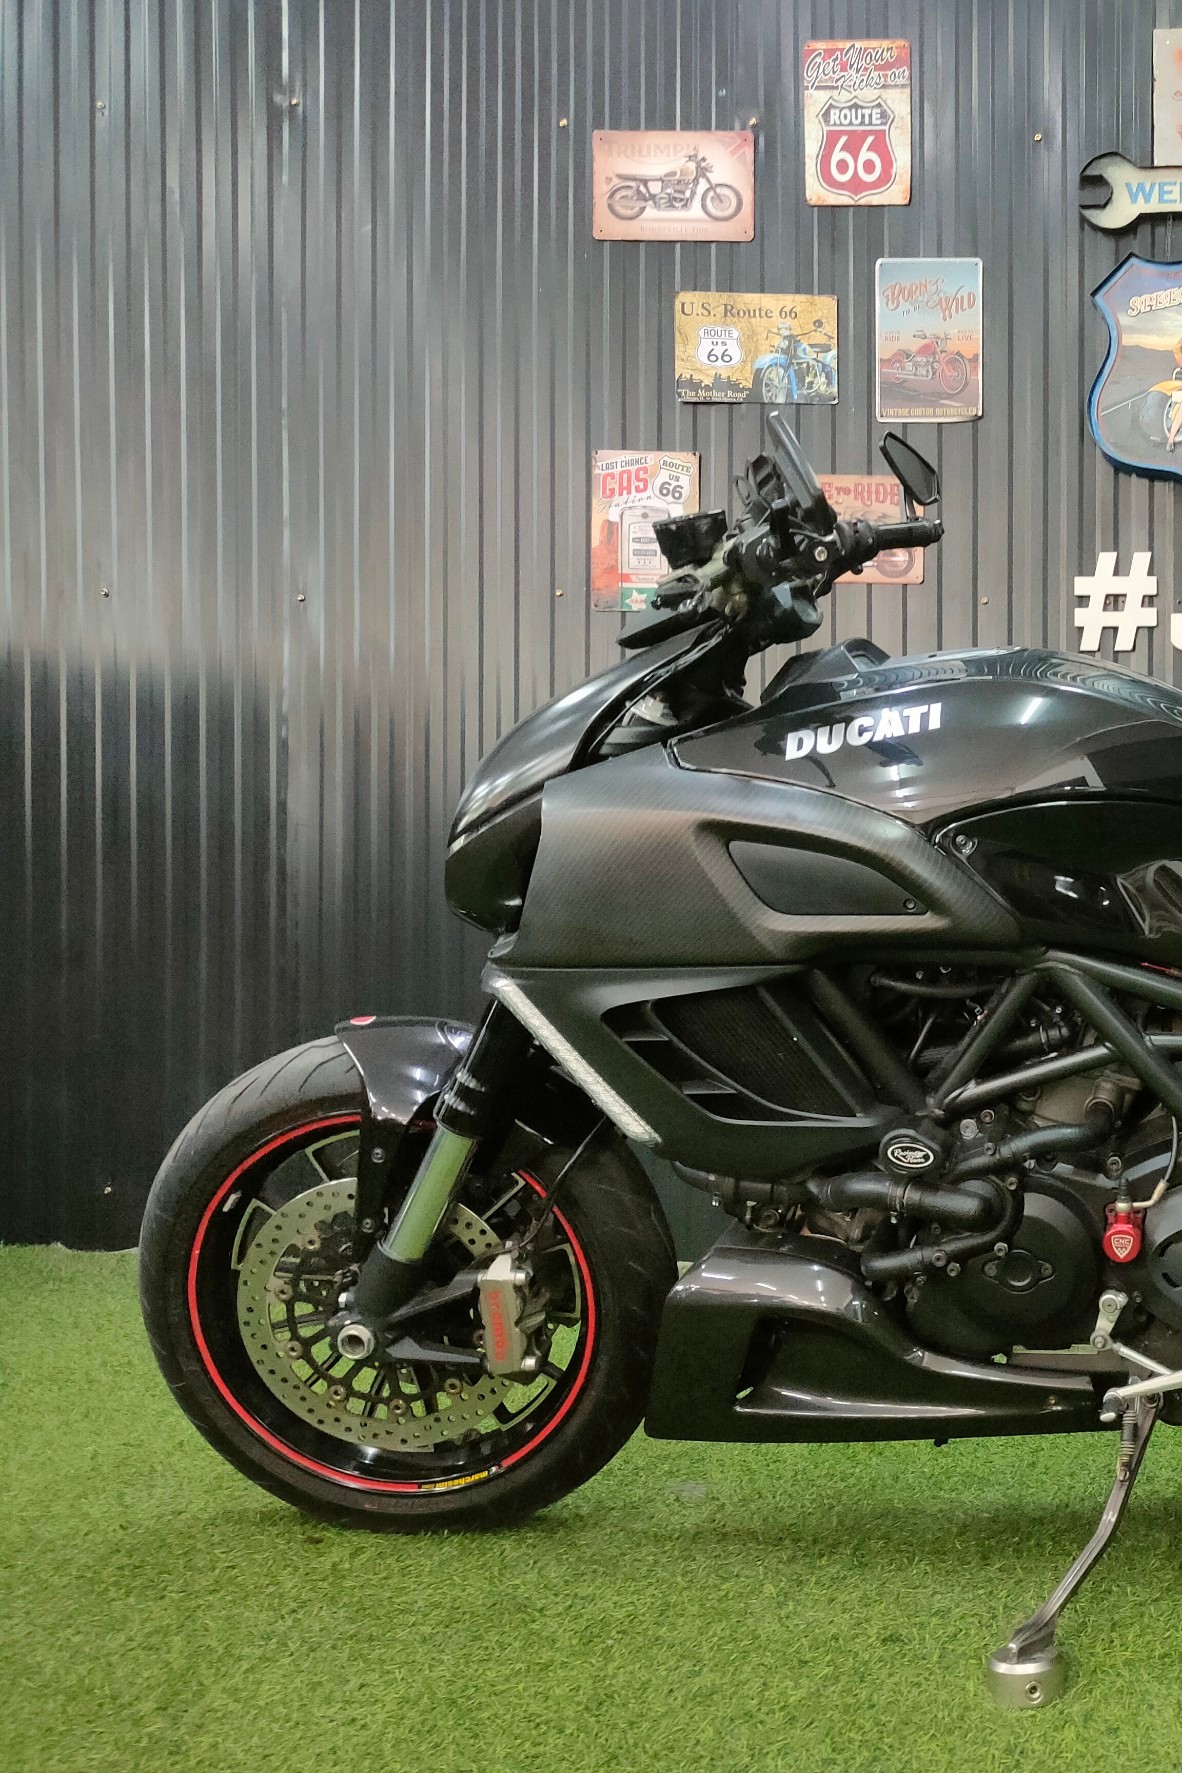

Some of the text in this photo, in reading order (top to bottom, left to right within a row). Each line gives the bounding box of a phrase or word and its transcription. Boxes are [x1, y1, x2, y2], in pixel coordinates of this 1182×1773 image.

[805, 43, 896, 90] Get Your
[835, 67, 908, 96] Kicks on
[829, 108, 882, 125] ROUTE
[830, 135, 882, 183] 66
[680, 302, 798, 320] U.S. Route 66
[703, 328, 734, 338] ROUTE
[706, 348, 733, 363] 66
[697, 389, 725, 397] Mother
[601, 456, 649, 471] LAST CHANCE
[662, 459, 692, 473] ROUTE
[601, 466, 649, 500] GAS
[668, 473, 681, 482] US
[659, 481, 684, 500] 66
[854, 482, 900, 506] RIDE
[785, 702, 942, 762] DUCATI
